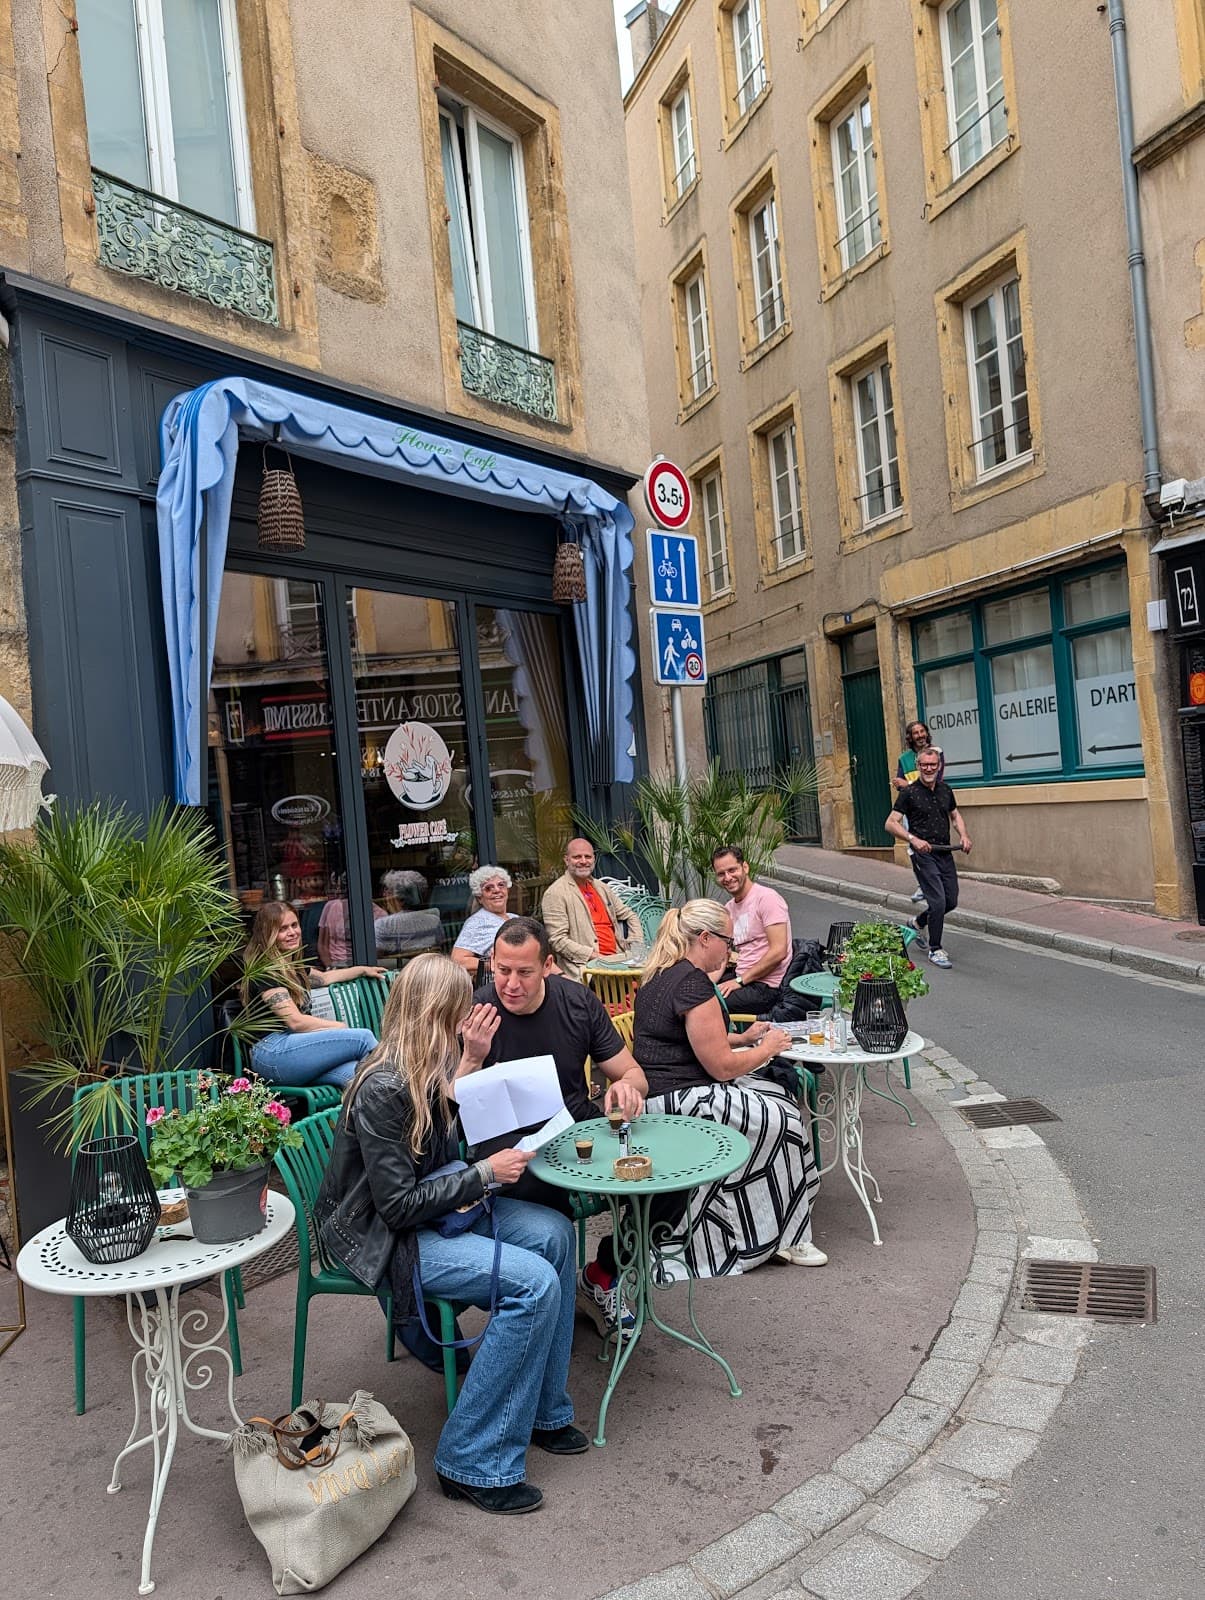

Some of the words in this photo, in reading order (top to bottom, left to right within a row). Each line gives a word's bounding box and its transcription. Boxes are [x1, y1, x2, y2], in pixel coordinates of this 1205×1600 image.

[392, 427, 452, 456] Flower
[657, 483, 683, 508] 3.5t
[1180, 587, 1194, 611] 72
[929, 708, 979, 731] CRIDART
[999, 696, 1057, 720] GALERIE
[1090, 682, 1137, 707] D'ART
